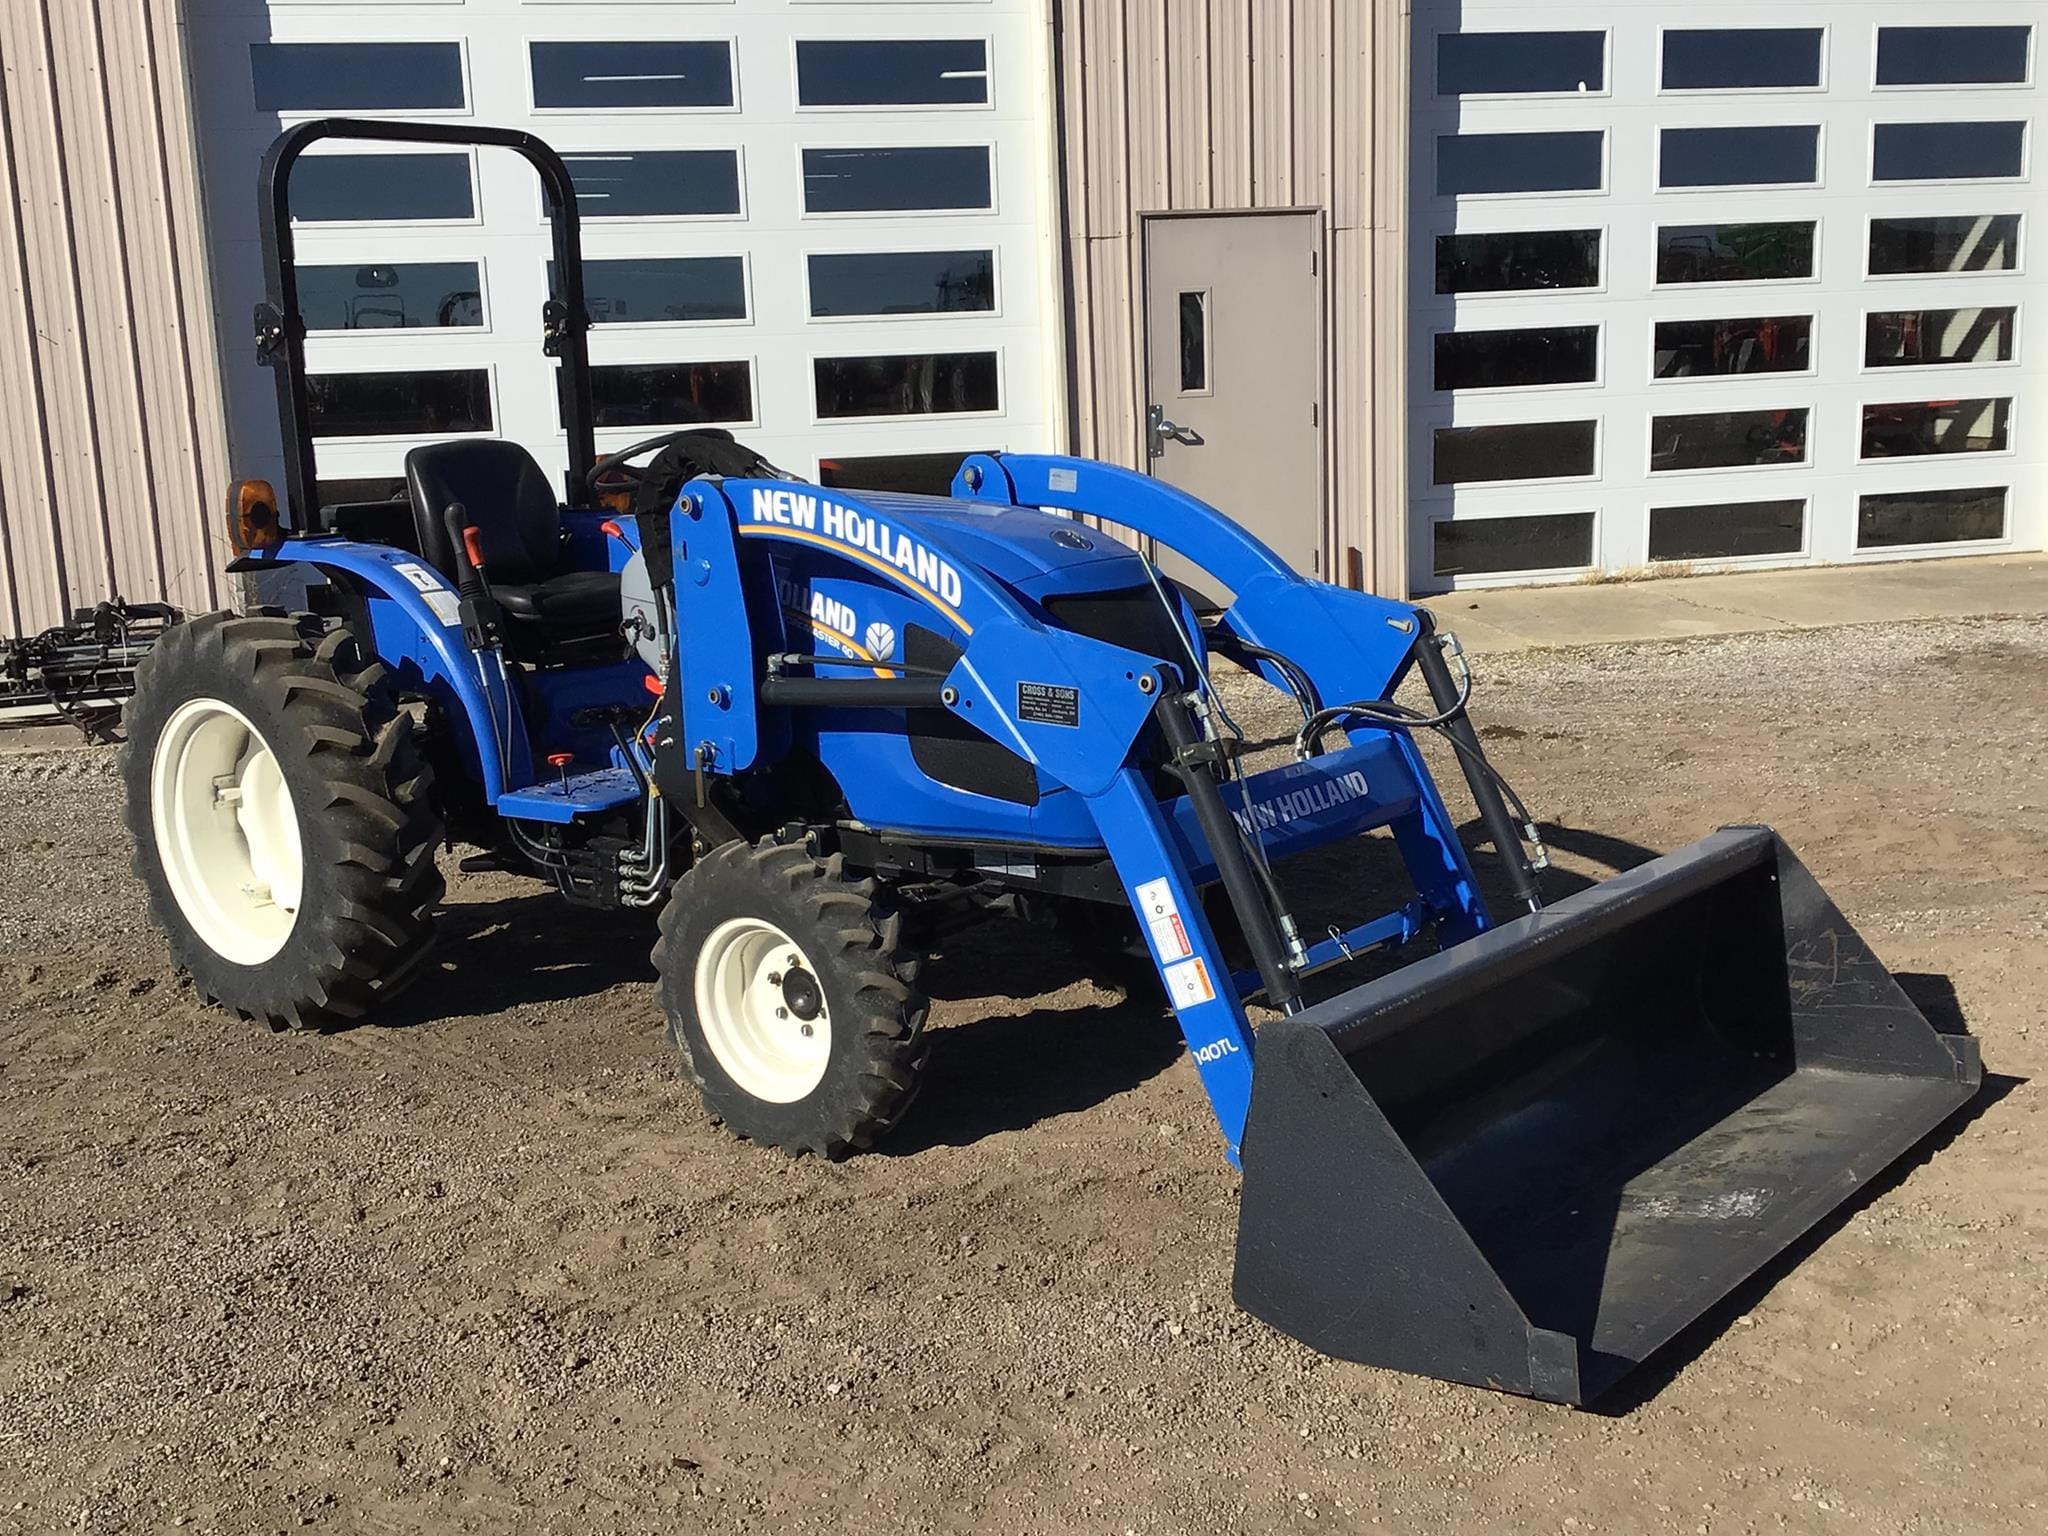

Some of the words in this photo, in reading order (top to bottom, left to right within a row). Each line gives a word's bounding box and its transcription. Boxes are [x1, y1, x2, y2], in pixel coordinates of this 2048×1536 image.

[752, 488, 817, 530] NEW
[822, 501, 962, 608] HOLLAND
[781, 580, 857, 638] OLLAND
[1022, 684, 1046, 697] CROSS
[1047, 687, 1054, 698] &
[1055, 689, 1075, 700] SONS
[1276, 770, 1369, 823] HOLLAND
